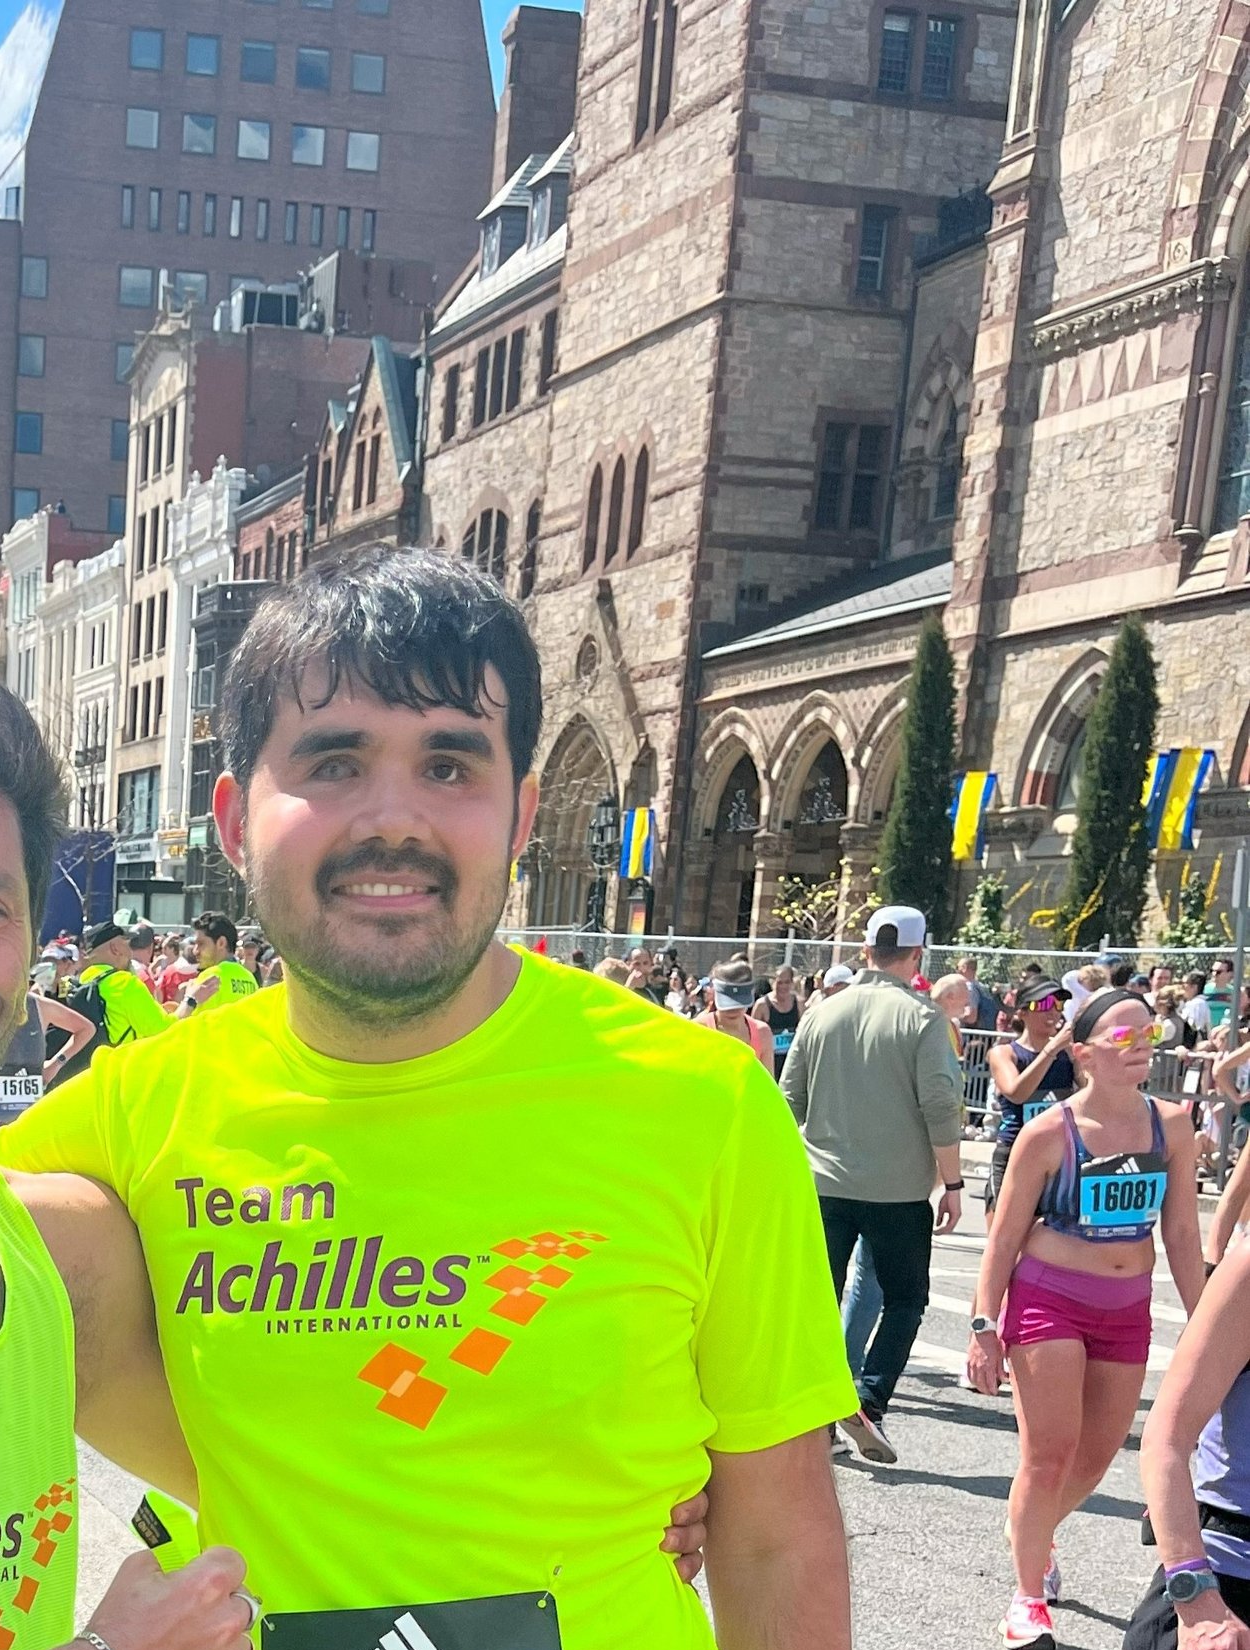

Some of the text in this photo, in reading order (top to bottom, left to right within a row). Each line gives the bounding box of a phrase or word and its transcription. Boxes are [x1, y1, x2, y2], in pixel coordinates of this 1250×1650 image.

[2, 1079, 39, 1096] 15165
[175, 1177, 335, 1229] Team
[1090, 1179, 1158, 1213] 16081
[266, 1313, 463, 1335] INTERNATIONAL
